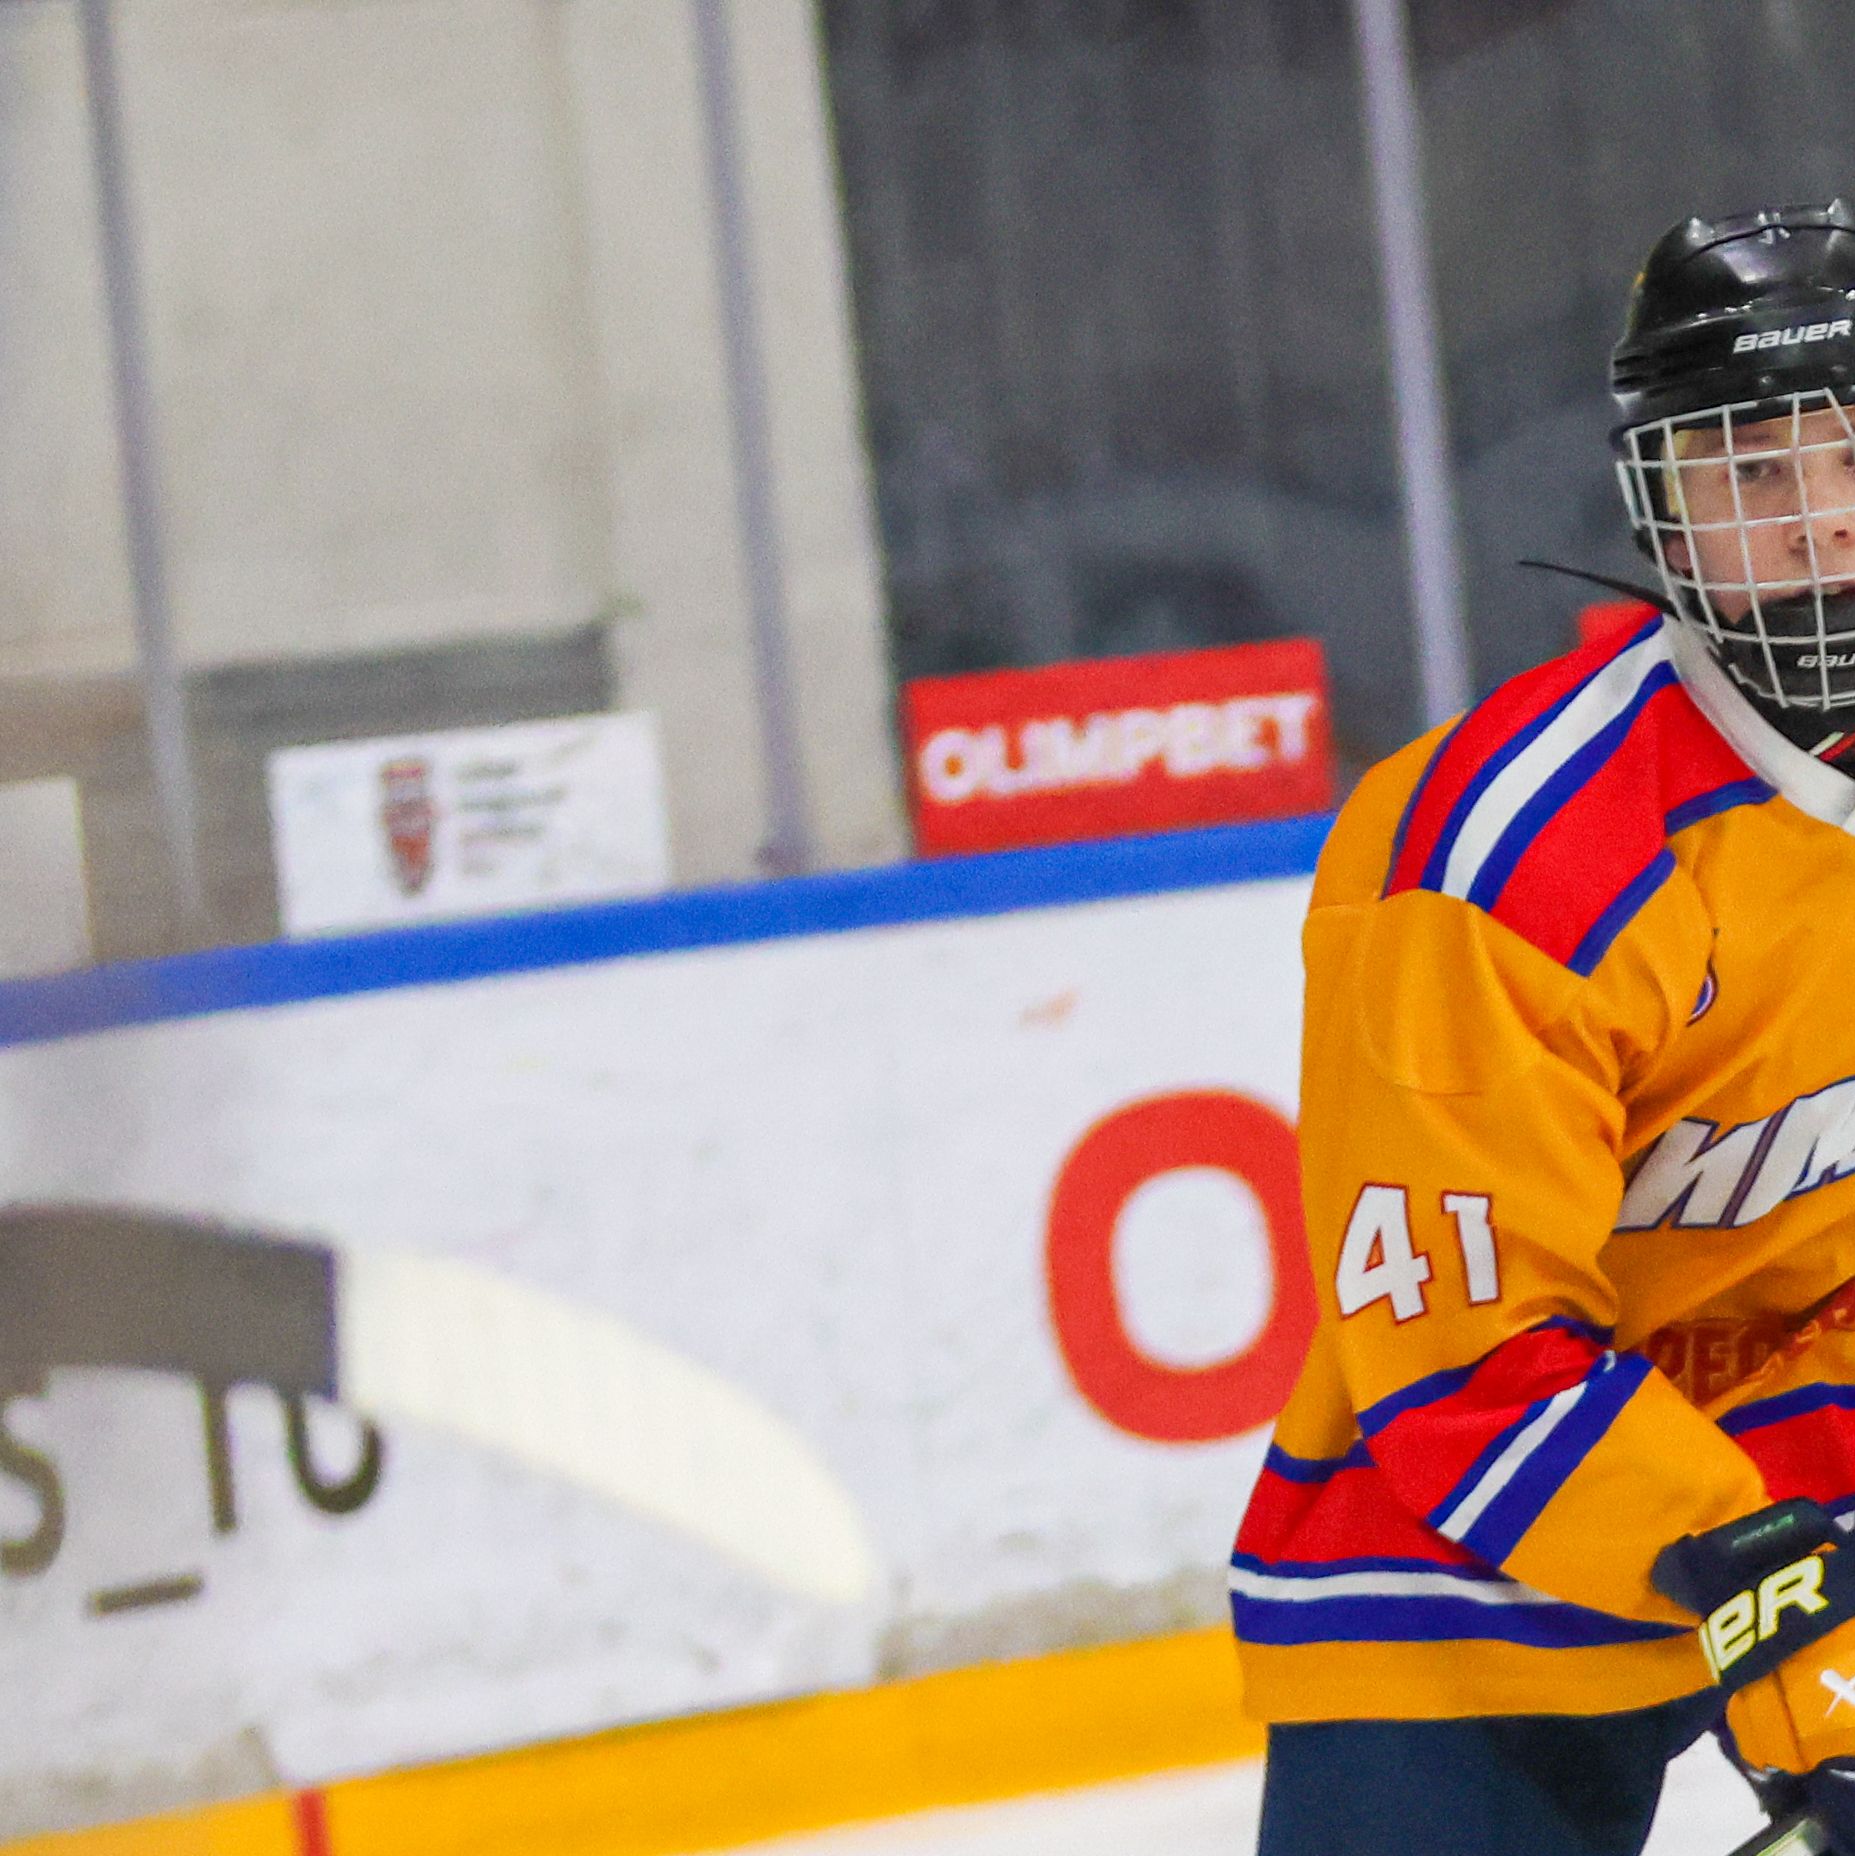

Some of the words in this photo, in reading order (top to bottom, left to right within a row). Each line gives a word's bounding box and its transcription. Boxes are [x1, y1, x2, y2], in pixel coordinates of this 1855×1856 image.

[1732, 318, 1853, 354] BAUER
[917, 692, 1317, 801] OLIMPBET
[1335, 1182, 1500, 1324] 41
